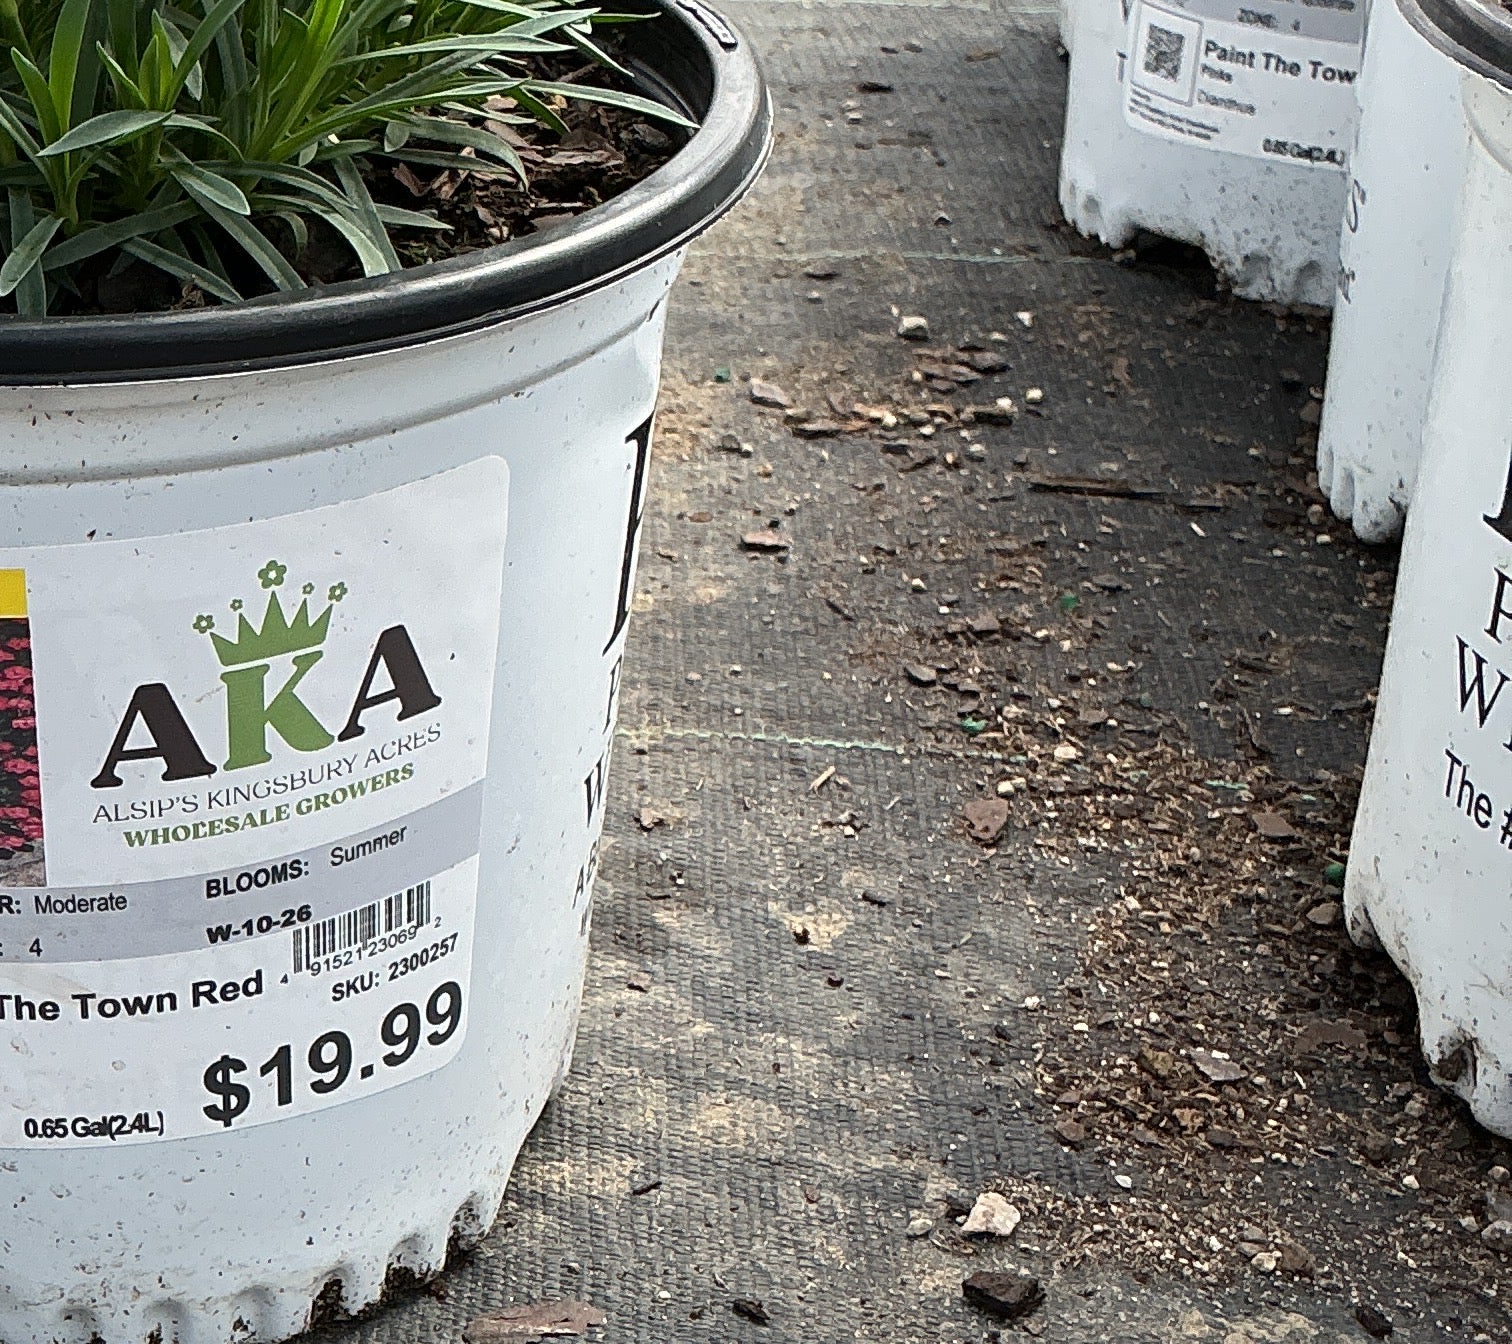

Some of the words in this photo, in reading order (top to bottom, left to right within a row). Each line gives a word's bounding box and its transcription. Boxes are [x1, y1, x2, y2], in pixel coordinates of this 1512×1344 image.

[1205, 39, 1255, 69] Paint
[1262, 52, 1302, 77] The
[1308, 60, 1358, 85] Tow
[90, 624, 442, 788] AKA
[93, 792, 199, 824] ALSIP'S
[207, 753, 359, 810] KINGSBURY
[364, 722, 442, 769] ACRES
[123, 804, 291, 848] WHOLESALE
[295, 762, 414, 817] GROWERS
[1445, 748, 1492, 829] The
[34, 892, 128, 915] Moderate
[206, 859, 309, 899] BLOOMS:
[330, 826, 407, 867] Summer
[29, 937, 43, 956] 4
[206, 904, 313, 945] W-10-26
[331, 972, 380, 1002] SKU:
[388, 932, 460, 982] 2300257
[71, 990, 177, 1019] Town
[192, 968, 263, 1008] Red
[203, 981, 462, 1128] $19.99
[24, 1117, 68, 1139] 0.65
